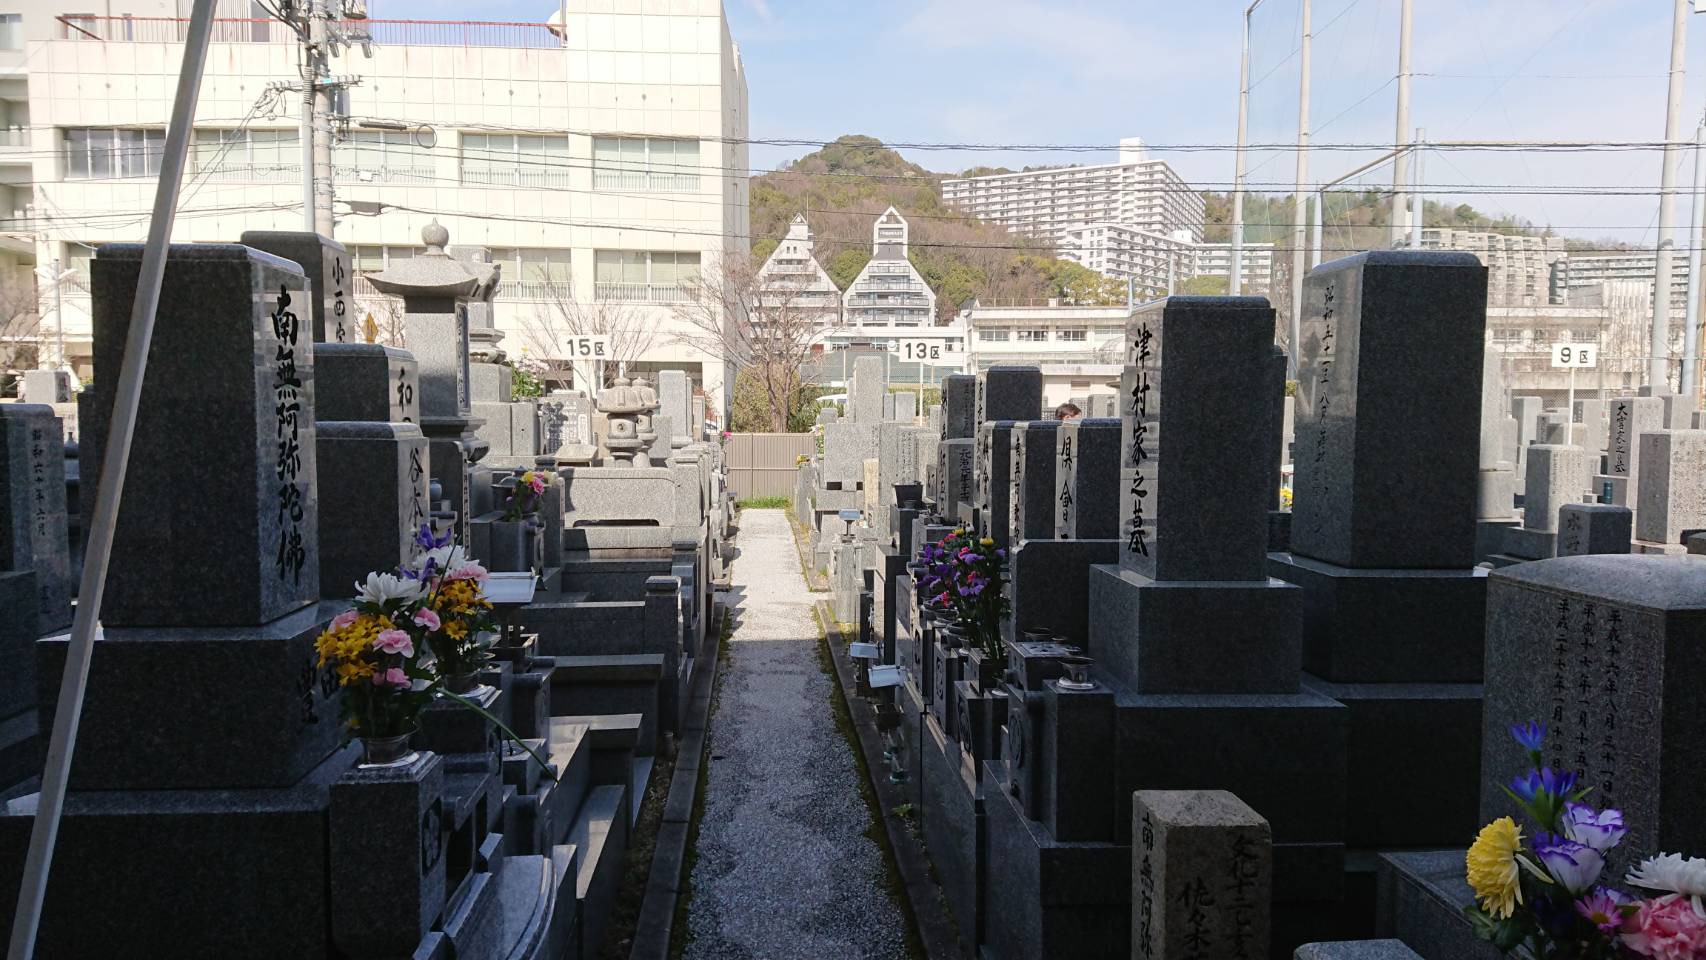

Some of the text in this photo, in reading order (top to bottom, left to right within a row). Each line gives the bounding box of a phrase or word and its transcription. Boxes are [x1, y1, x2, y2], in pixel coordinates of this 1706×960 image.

[566, 337, 605, 357] 15区
[905, 342, 940, 359] 13区
[1560, 346, 1589, 364] 9区
[397, 366, 413, 422] 和
[1127, 321, 1153, 557] 津村家之墓
[1175, 877, 1215, 959] 佐々木
